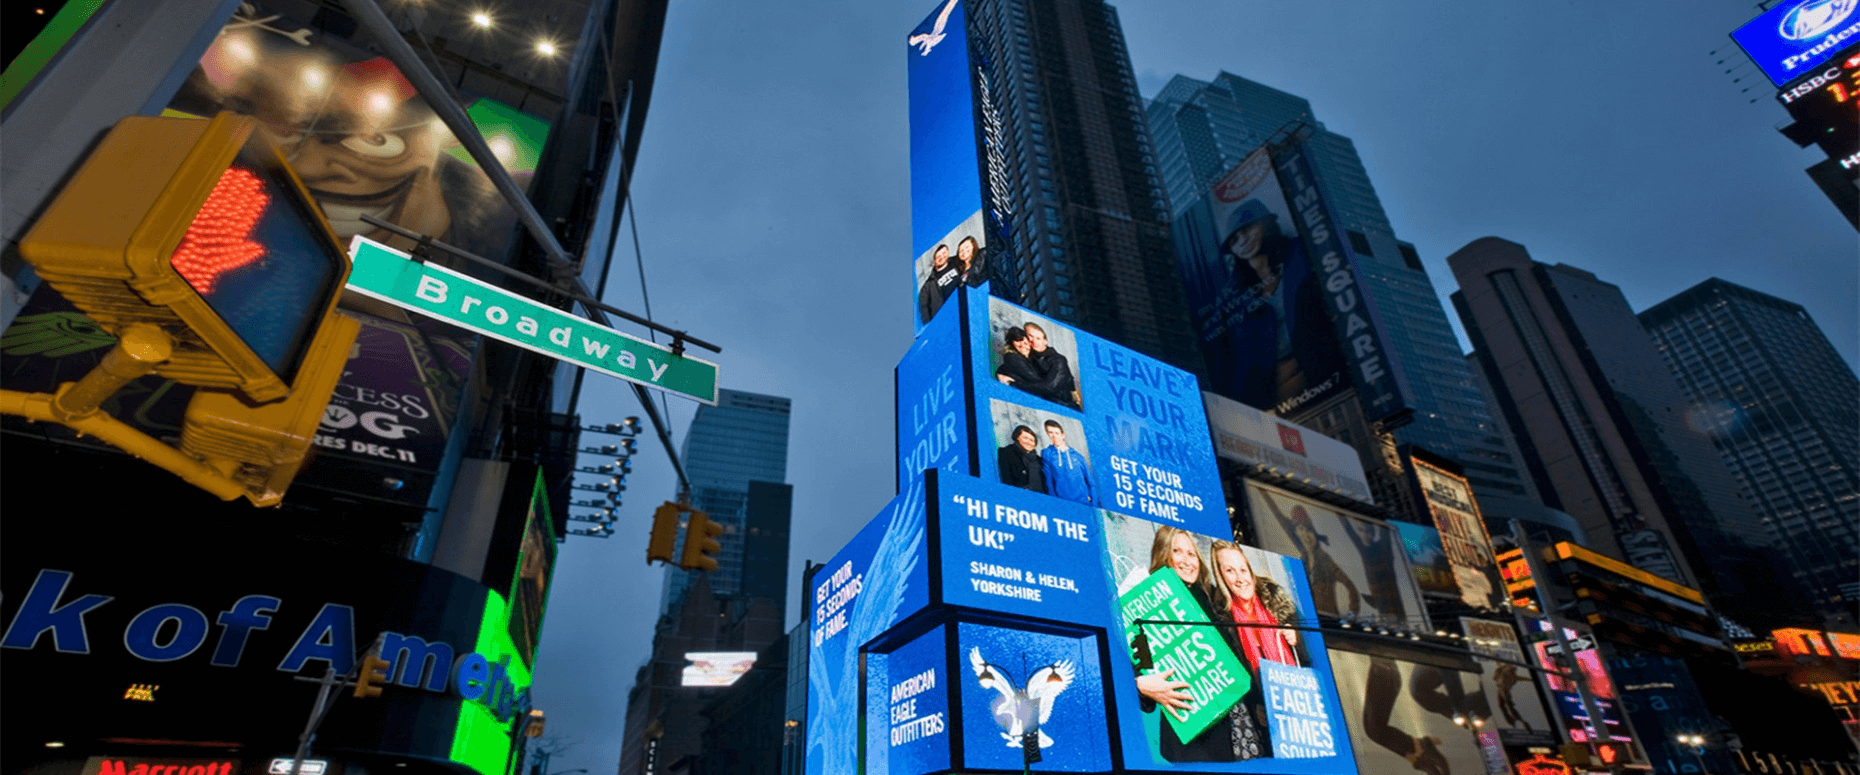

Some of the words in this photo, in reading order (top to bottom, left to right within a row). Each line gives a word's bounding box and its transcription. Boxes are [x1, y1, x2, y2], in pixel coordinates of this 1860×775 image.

[1780, 66, 1842, 104] HSBC
[1278, 153, 1330, 245] TIMES
[414, 273, 669, 382] Broadway
[1321, 250, 1385, 385] SQUARE
[1092, 342, 1182, 399] LEAVE
[913, 364, 955, 437] LIVE
[1108, 379, 1191, 434] YOUR
[1276, 380, 1334, 414] Windows
[1331, 371, 1341, 384] 7
[904, 411, 958, 484] YOUR
[1105, 414, 1192, 471] MARK
[1110, 454, 1138, 477] GET
[1142, 463, 1184, 490] YOUR
[1113, 472, 1134, 492] 15
[1136, 478, 1204, 512] SECONDS
[995, 503, 1049, 534] FROM
[1052, 517, 1090, 543] THE
[1115, 490, 1136, 510] OF
[1139, 496, 1186, 523] FAME.
[968, 525, 1016, 551] UK!”
[816, 582, 830, 605] GET
[831, 559, 854, 592] YOUR
[970, 560, 1023, 582] SHARON
[1025, 570, 1036, 585] &
[1038, 572, 1080, 594] HELEN,
[970, 577, 1043, 603] YORKSHIRE
[816, 603, 826, 626] 15
[826, 573, 863, 616] SECONDS
[123, 594, 282, 668] of
[815, 628, 825, 648] OF
[825, 609, 849, 641] FAME.
[891, 668, 936, 706] AMERICAN
[1270, 686, 1328, 719] EAGLE
[891, 698, 918, 726] EAGLE
[891, 712, 945, 748] OUTFITTERS
[1274, 714, 1334, 749] TIMES
